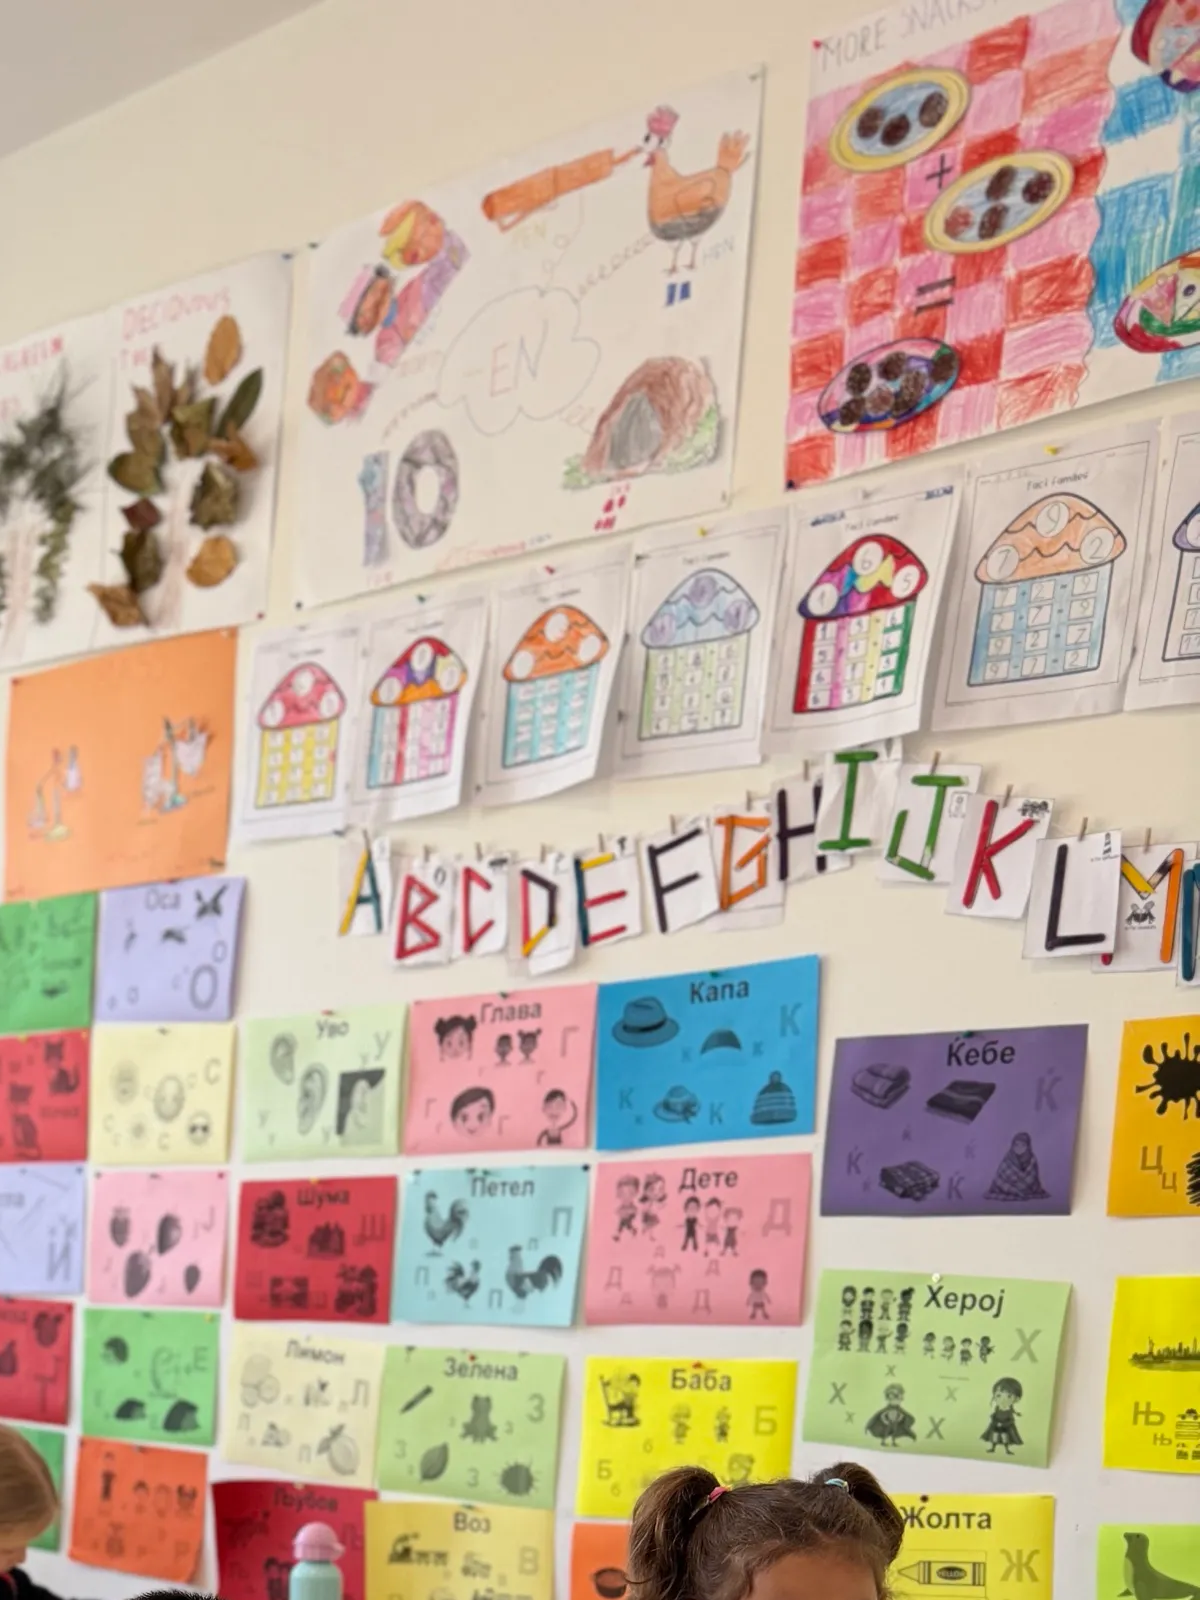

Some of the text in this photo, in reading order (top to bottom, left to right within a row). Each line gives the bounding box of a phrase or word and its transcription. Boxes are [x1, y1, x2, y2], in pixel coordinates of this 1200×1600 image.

[820, 17, 888, 72] MORE
[997, 549, 1011, 568] 7
[1089, 537, 1103, 559] 2
[339, 848, 383, 936] A
[395, 873, 441, 960] B
[461, 866, 494, 953] C
[521, 867, 559, 957] D
[573, 852, 628, 947] E
[648, 827, 702, 934] F
[776, 783, 828, 881] H
[818, 750, 878, 851] I
[885, 774, 970, 880] J
[962, 799, 1038, 909] K
[1045, 843, 1107, 951] L
[688, 975, 751, 1004] Капа
[480, 1000, 544, 1024] Глава
[780, 1005, 803, 1036] К
[316, 1018, 350, 1040] Уво
[946, 1036, 1016, 1068] Ќебе
[1140, 1144, 1164, 1174] Ц
[470, 1175, 536, 1199] Петел
[679, 1168, 739, 1194] Дете
[297, 1187, 350, 1209] Шума
[924, 1282, 1006, 1319] Херој
[285, 1339, 346, 1367] Лимон
[1011, 1327, 1042, 1364] Х
[443, 1355, 520, 1384] Зелена
[670, 1366, 732, 1392] Баба
[454, 1510, 492, 1535] Воз
[901, 1505, 993, 1532] Жолта
[999, 1548, 1042, 1585] Ж
